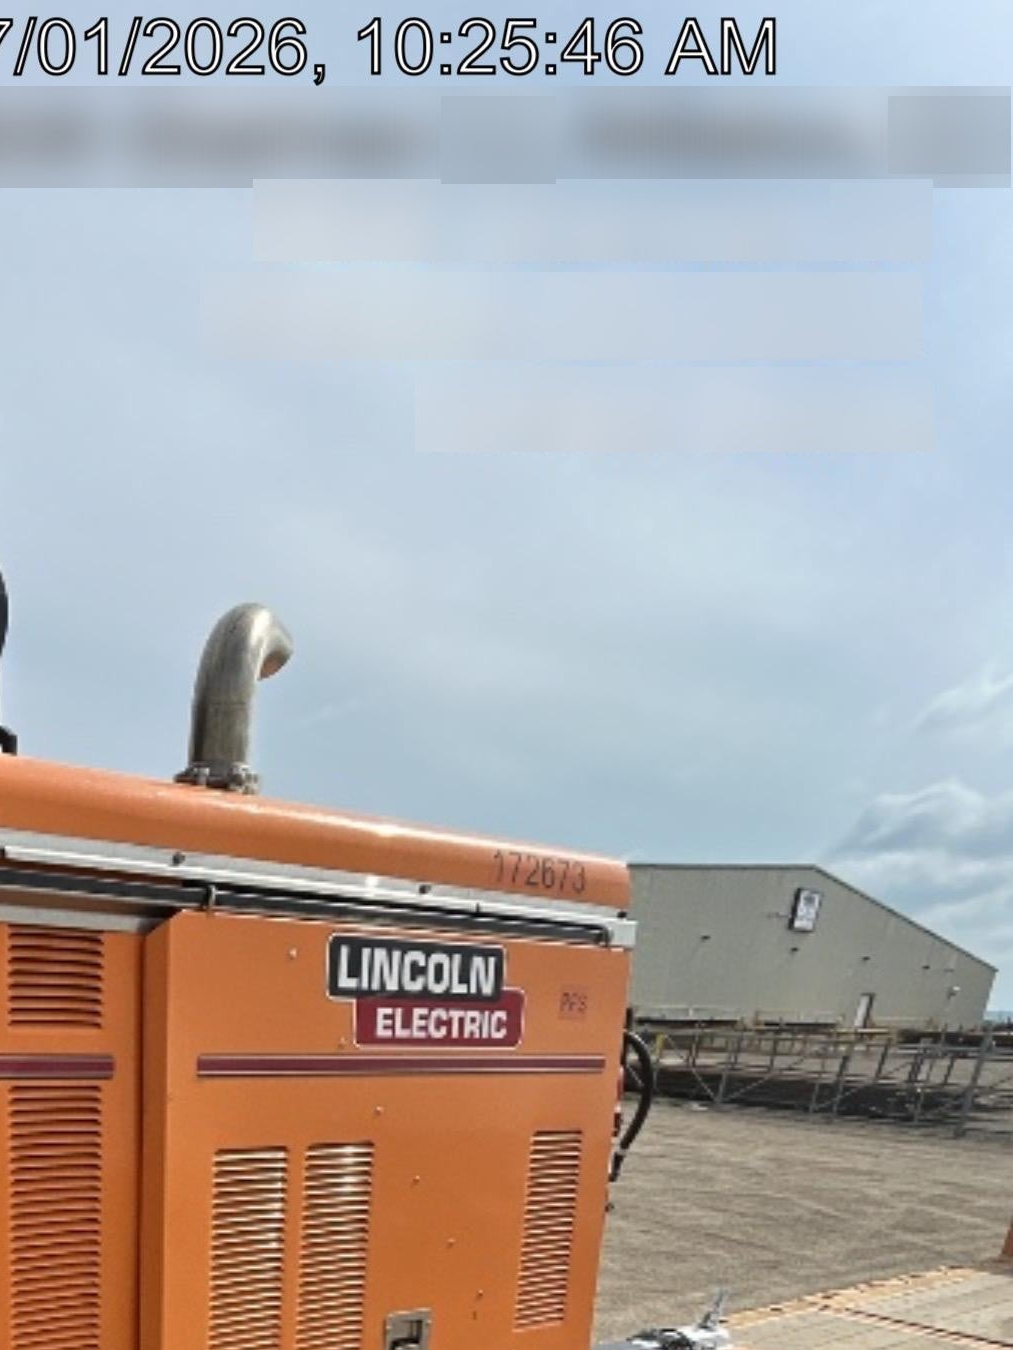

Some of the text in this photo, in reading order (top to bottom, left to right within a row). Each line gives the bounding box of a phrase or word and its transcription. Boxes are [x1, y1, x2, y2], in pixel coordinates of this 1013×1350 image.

[493, 849, 586, 895] 172673
[338, 944, 496, 997] LINCOLN
[375, 1007, 508, 1040] ELECTRIC
